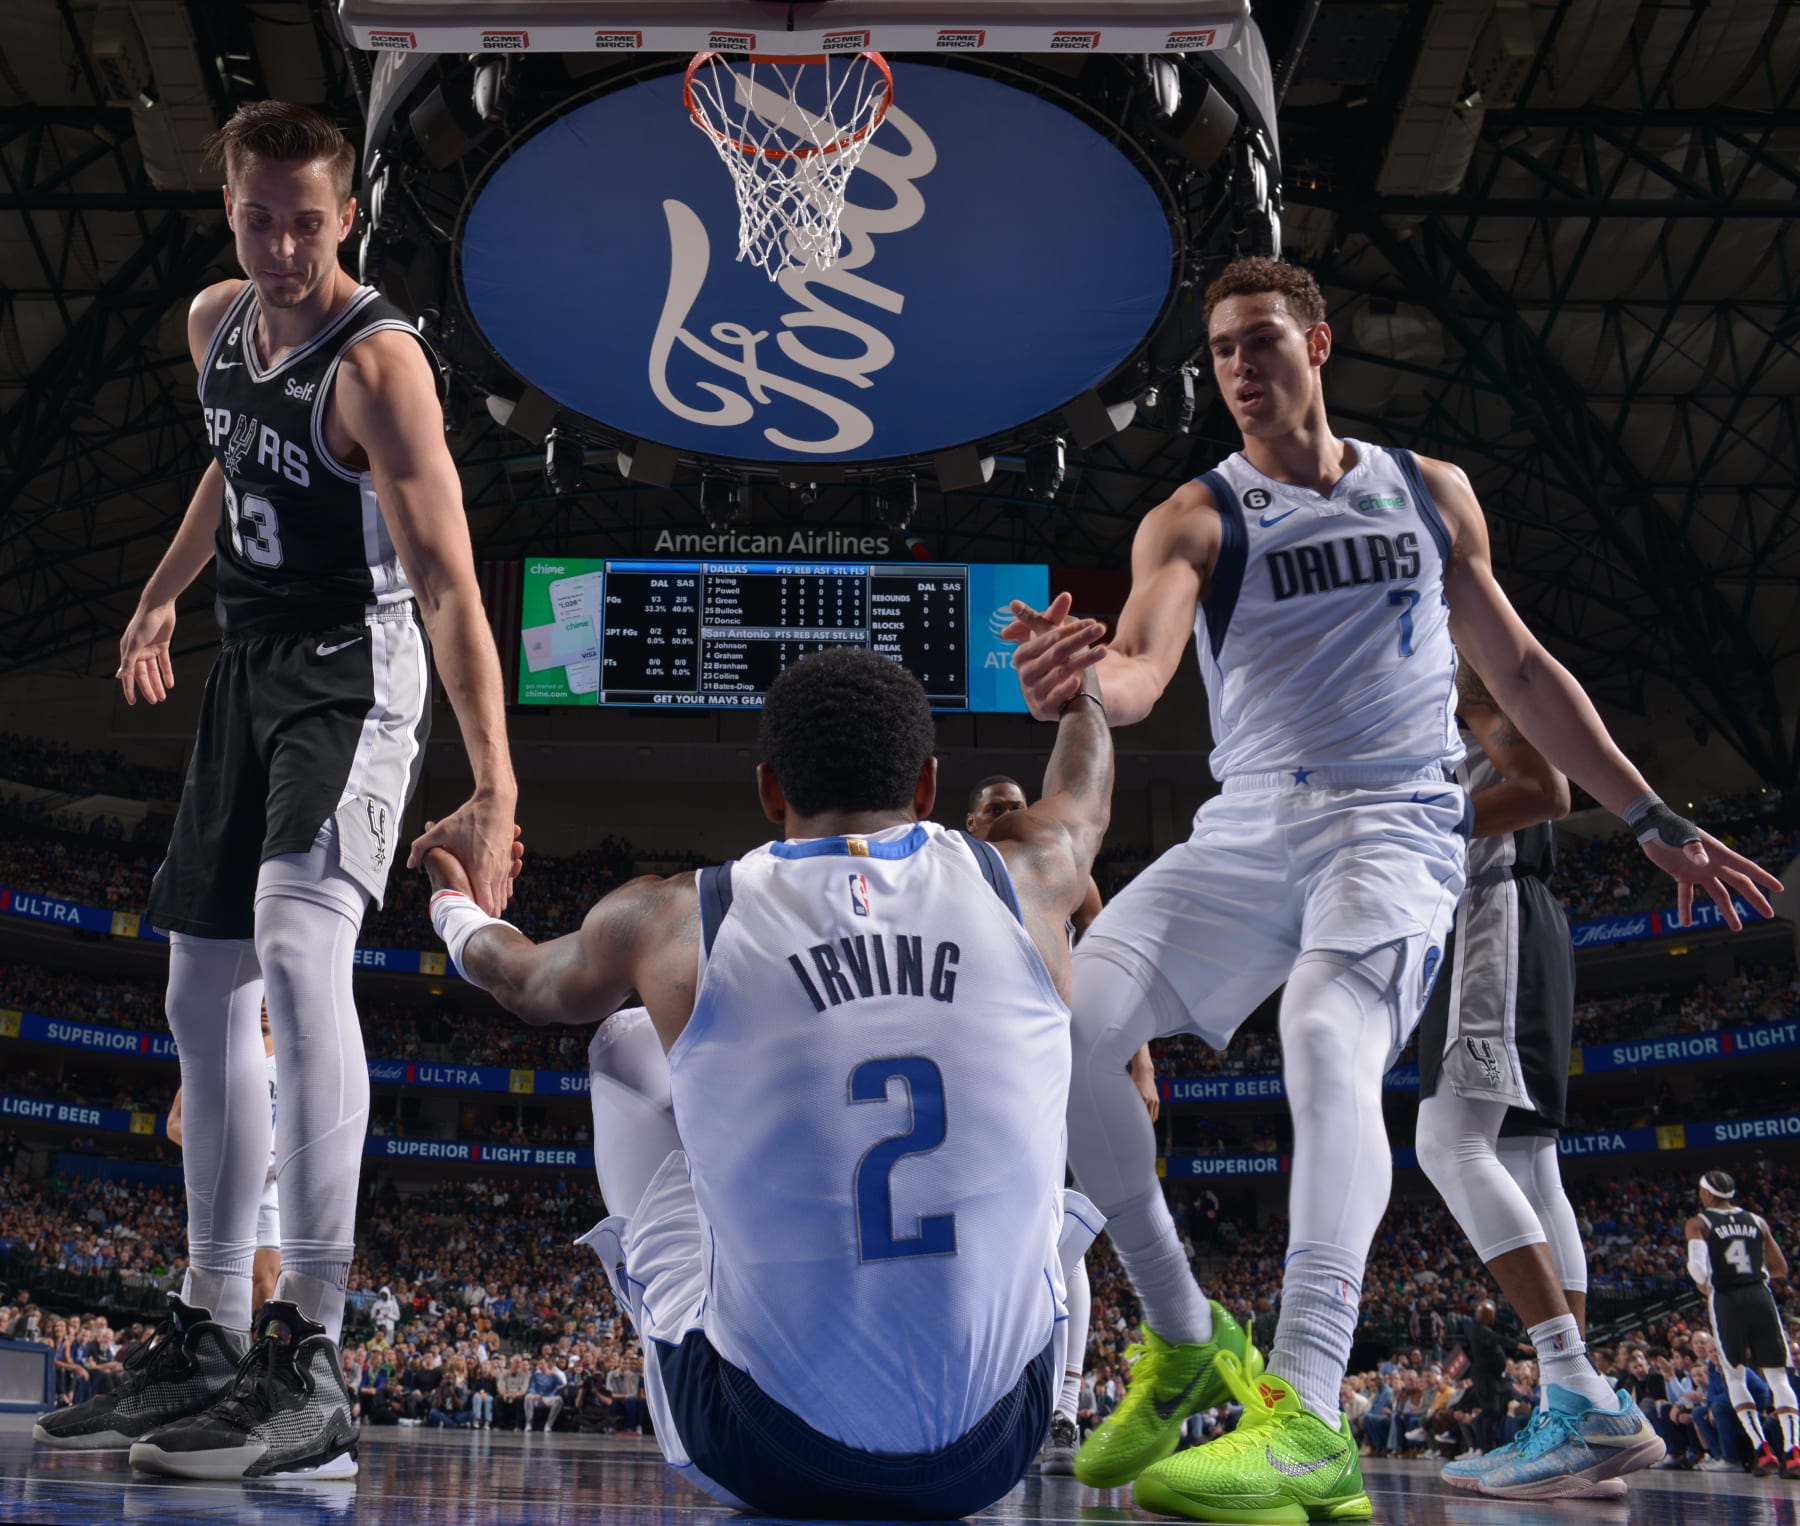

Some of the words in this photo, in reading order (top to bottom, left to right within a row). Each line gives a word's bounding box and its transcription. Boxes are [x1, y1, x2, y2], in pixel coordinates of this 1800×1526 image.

[822, 41, 862, 49] BRICK
[648, 72, 937, 454] Ford
[227, 326, 241, 346] 6
[1249, 493, 1266, 507] 6
[1359, 494, 1406, 513] chime
[654, 530, 782, 554] American
[787, 531, 889, 554] Airlines
[530, 564, 565, 574] chime
[1266, 532, 1421, 601] DALLAS
[566, 621, 589, 631] chime
[1387, 589, 1421, 658] 7
[705, 629, 726, 638] San
[728, 630, 770, 638] Antonio
[525, 690, 568, 698] chime.com
[654, 695, 672, 703] GET
[676, 695, 704, 704] YOUR
[708, 696, 738, 704] MAVS
[14, 895, 80, 924] ULTRA
[353, 950, 386, 966] EER
[788, 934, 960, 1013] IRVING
[48, 1023, 137, 1050] SUPERIOR
[153, 1038, 180, 1056] LIG
[1614, 1038, 1718, 1064] SUPERIOR
[1736, 1025, 1797, 1050] LIGHT
[420, 1068, 481, 1085] ULTRA
[1174, 1082, 1229, 1098] LIGHT
[1234, 1080, 1281, 1096] BEER
[2, 1098, 53, 1119] LIGHT
[58, 1106, 100, 1125] BEER
[1715, 1116, 1800, 1141] SUPERIO
[387, 1140, 469, 1158] SUPERIOR
[482, 1148, 532, 1163] LIGHT
[536, 1151, 576, 1164] BEER
[1559, 1135, 1626, 1154] ULTRA
[848, 1054, 959, 1264] 2
[1192, 1158, 1278, 1174] SUPERIOR
[1715, 1224, 1757, 1239] GRAHAM
[1724, 1240, 1752, 1274] 4
